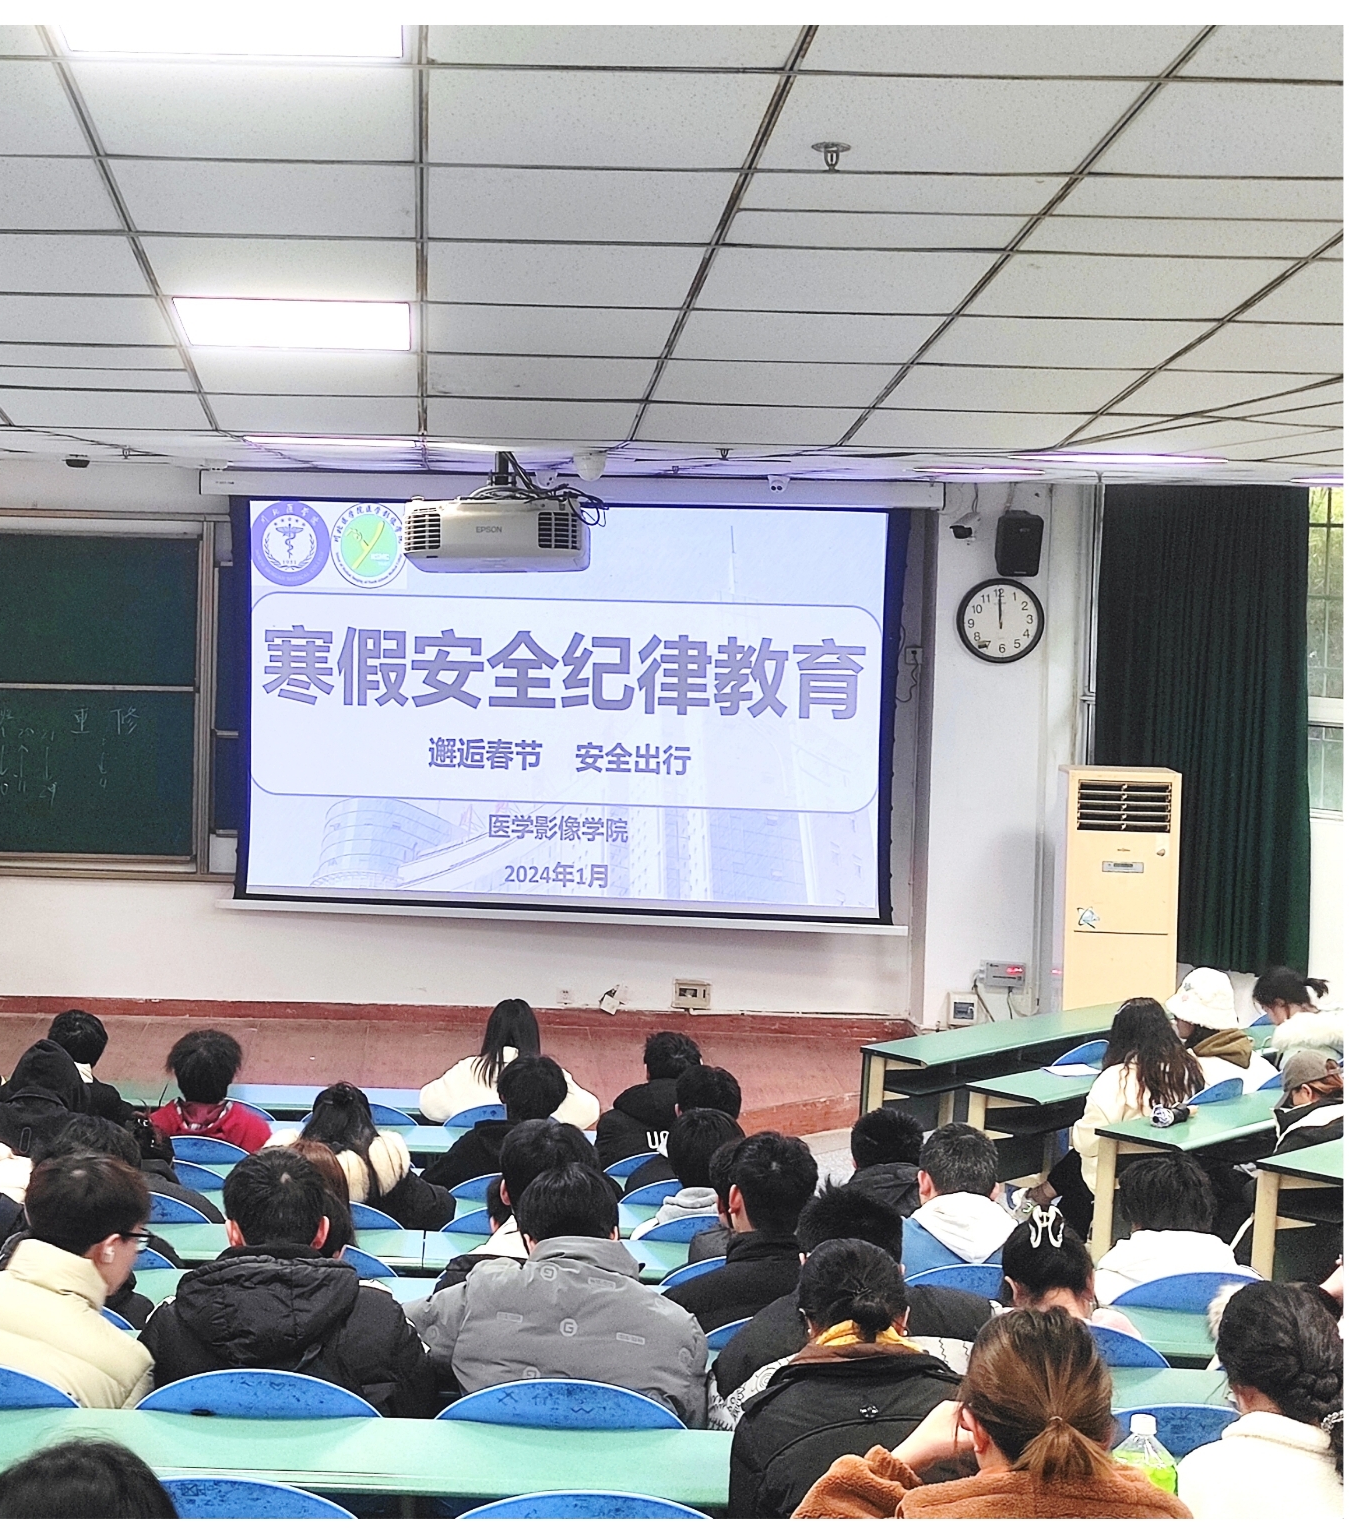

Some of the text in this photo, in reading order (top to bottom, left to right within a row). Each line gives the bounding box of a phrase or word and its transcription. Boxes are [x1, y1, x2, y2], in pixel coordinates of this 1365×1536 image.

[475, 526, 503, 534] EPSON
[993, 588, 1005, 598] 12
[1013, 592, 1017, 601] 1
[981, 594, 990, 603] 11
[971, 604, 983, 614] 10
[1021, 601, 1029, 611] 2
[968, 619, 975, 628] 9
[1026, 614, 1034, 624] 3
[973, 631, 981, 641] 8
[1023, 629, 1030, 638] 4
[998, 643, 1006, 653] 6
[1014, 639, 1021, 648] 5
[262, 623, 868, 720] 寒假安全纪律教育
[428, 736, 693, 776] 邂逅春节 安全出行
[488, 814, 629, 843] 医学影像学院
[504, 862, 610, 889] 2024年1月
